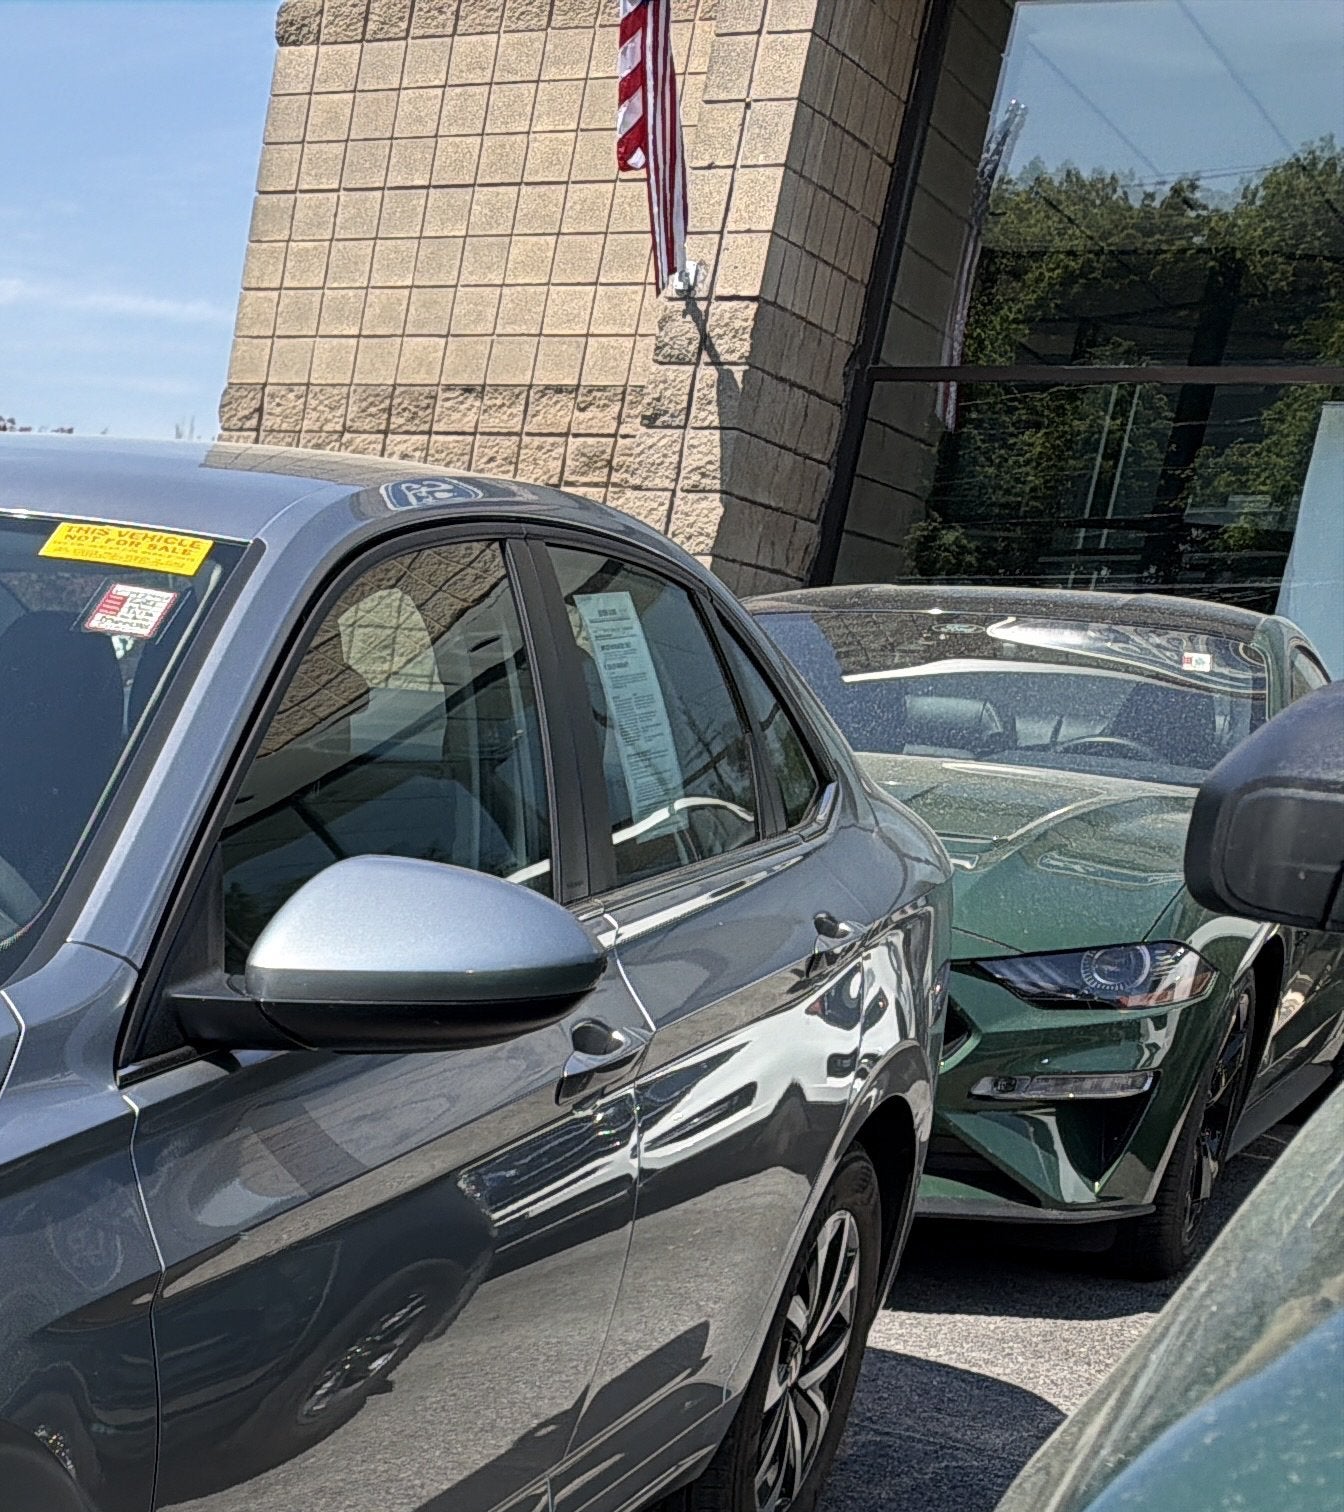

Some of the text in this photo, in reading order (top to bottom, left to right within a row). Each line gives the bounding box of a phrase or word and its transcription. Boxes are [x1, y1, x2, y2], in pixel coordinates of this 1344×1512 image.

[64, 534, 100, 543] NOT
[105, 537, 141, 548] FOR
[147, 542, 193, 556] SALE
[66, 525, 202, 550] THIS VEHICLE
